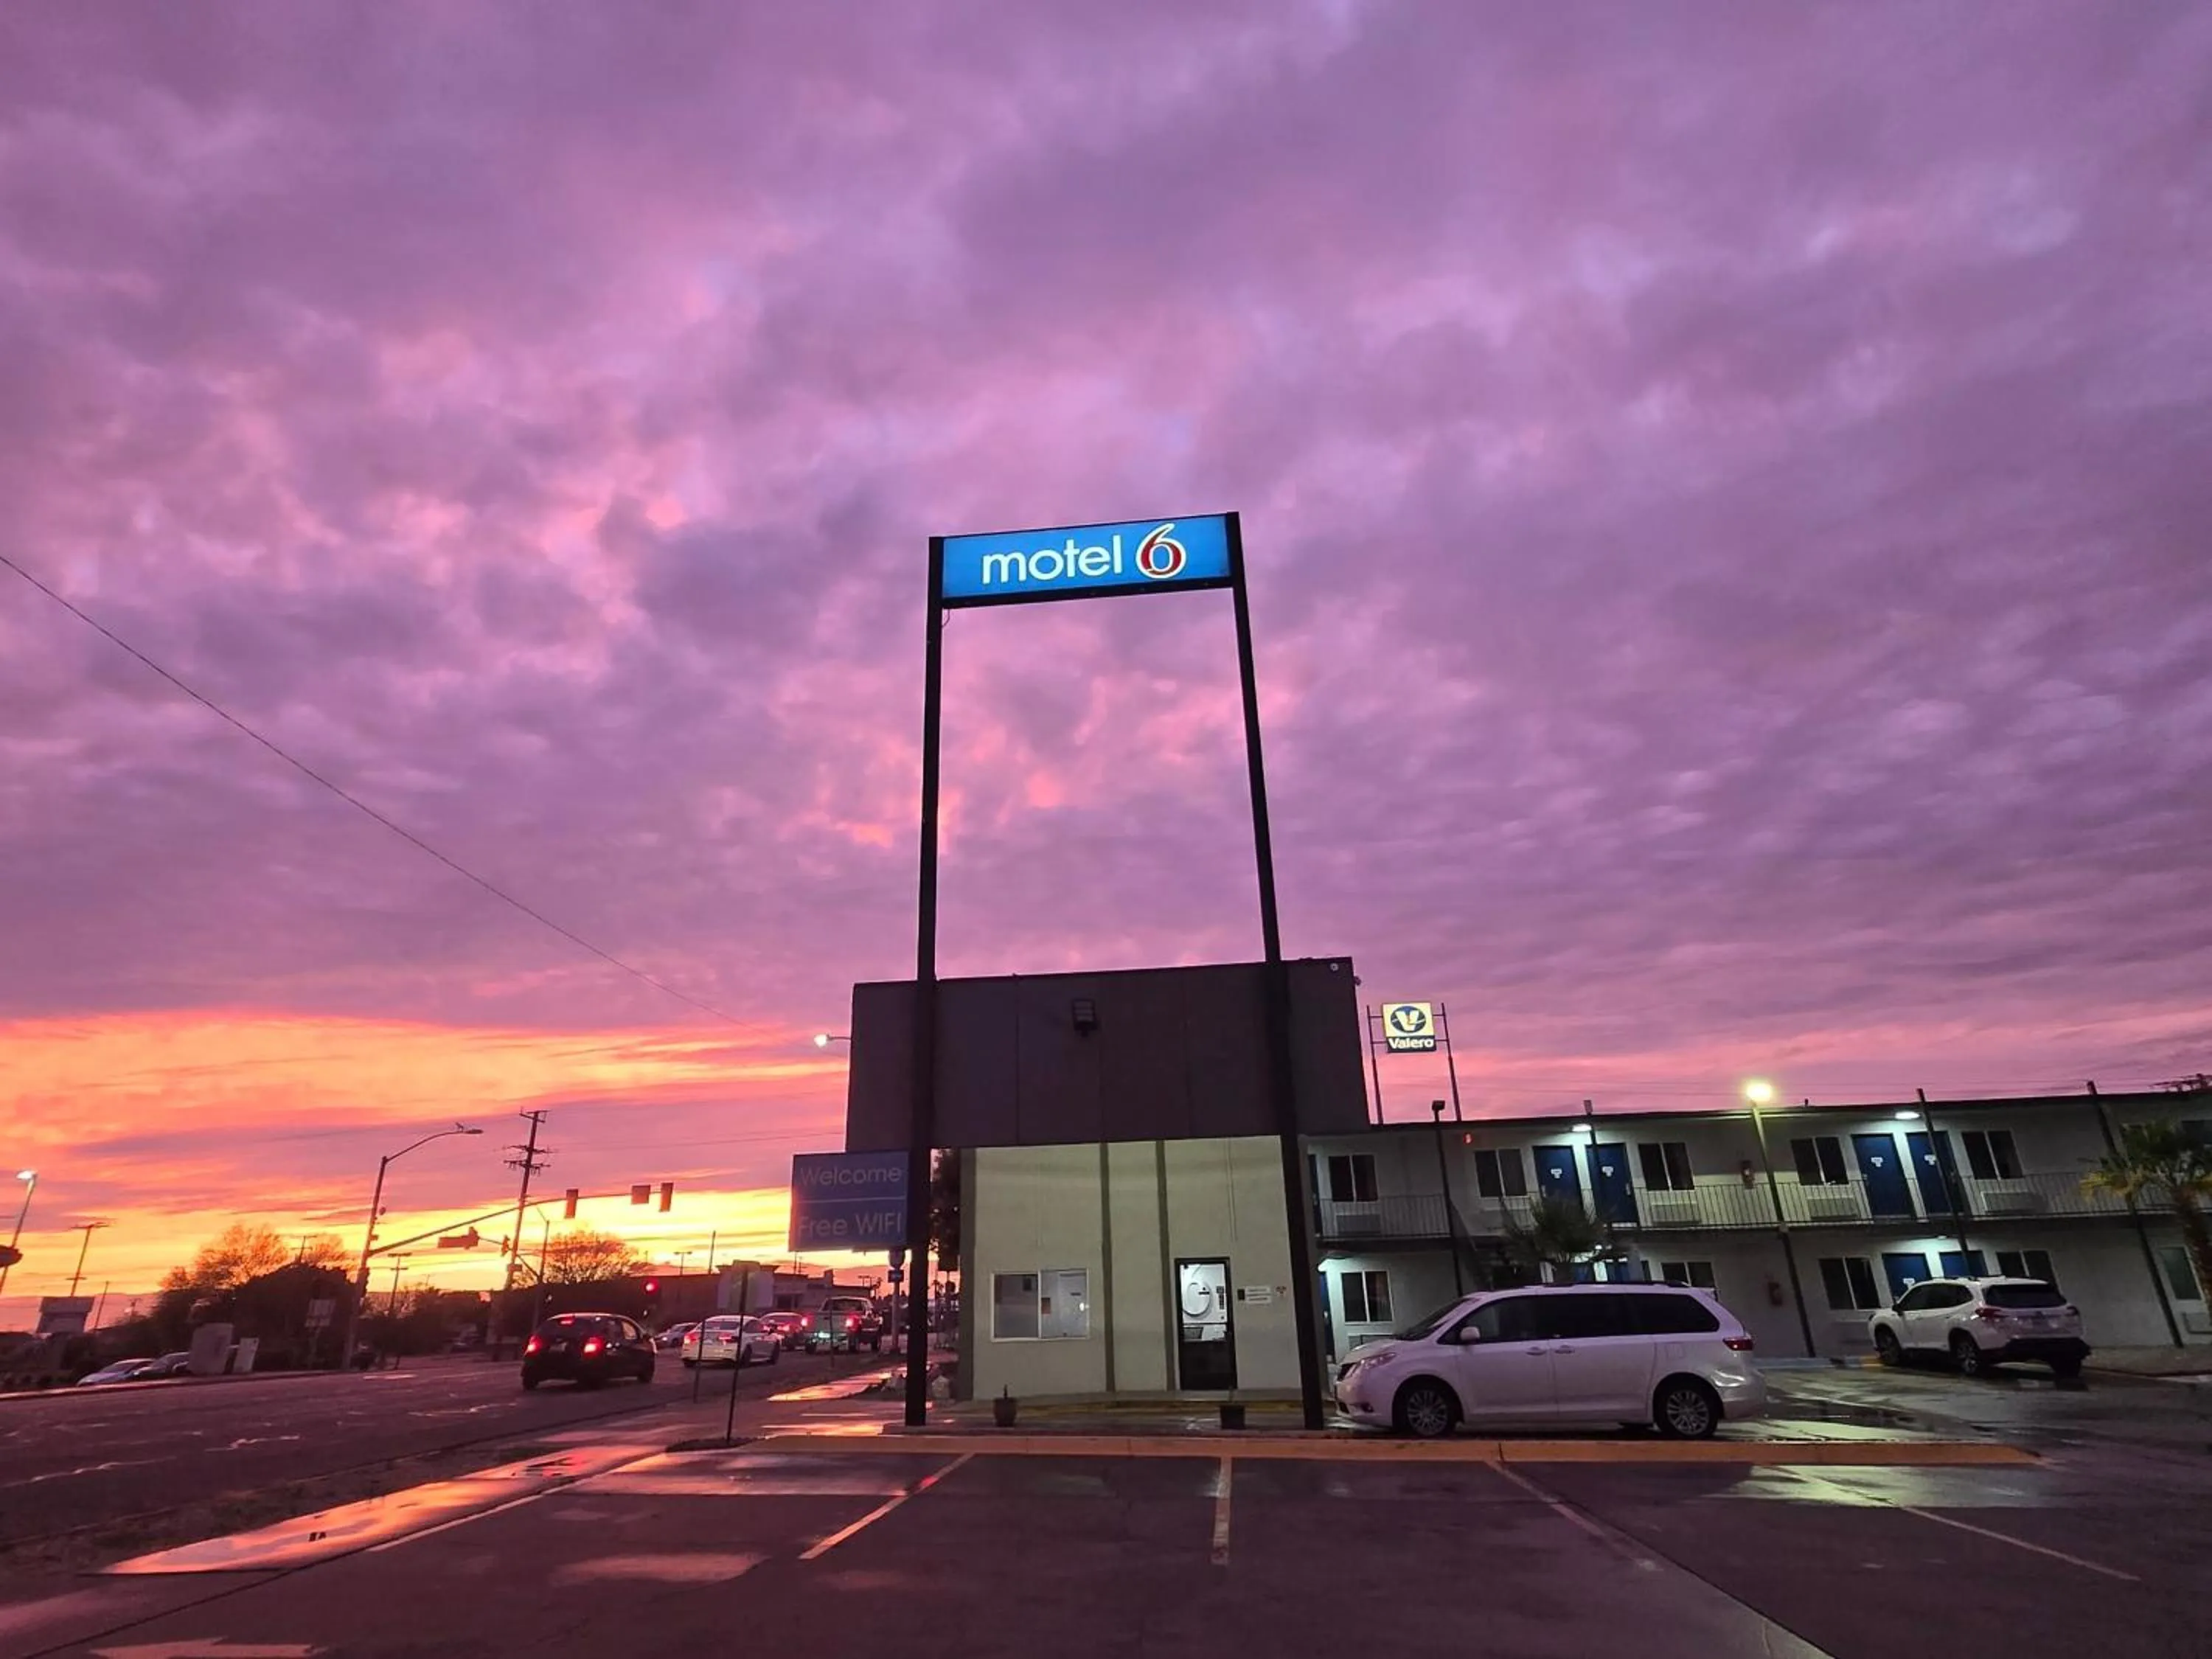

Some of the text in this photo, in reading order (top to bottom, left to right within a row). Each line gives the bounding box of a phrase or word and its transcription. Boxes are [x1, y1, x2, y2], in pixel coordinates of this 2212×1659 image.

[983, 523, 1186, 584] motel 6
[1388, 1037, 1434, 1049] Valero
[800, 1166, 902, 1186] Welcome
[798, 1217, 848, 1239] Free
